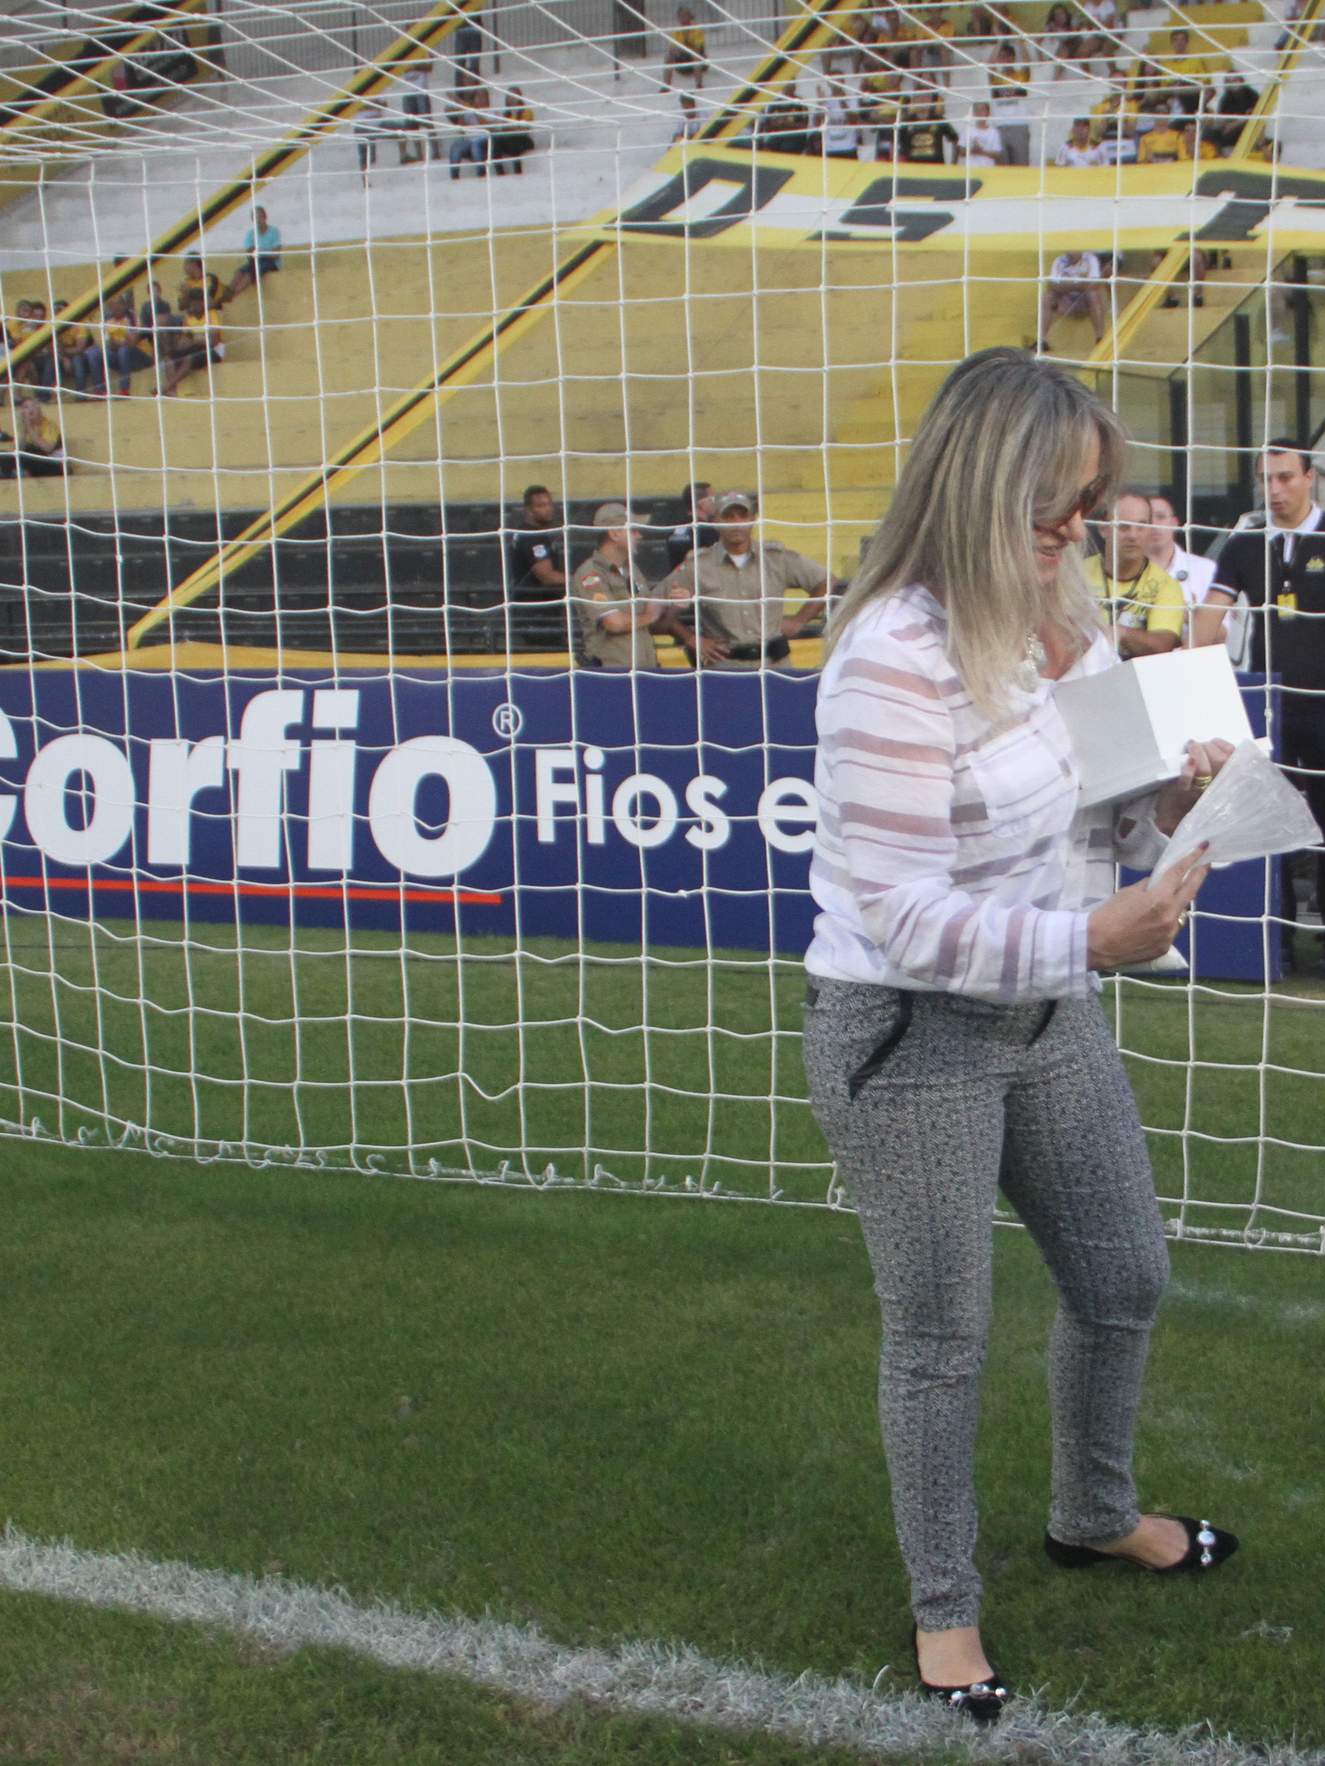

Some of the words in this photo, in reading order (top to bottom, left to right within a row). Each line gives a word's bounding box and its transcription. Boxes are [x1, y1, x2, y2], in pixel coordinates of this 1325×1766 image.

[0, 688, 498, 877] orfio
[535, 747, 732, 850] Fios
[758, 776, 818, 853] e
